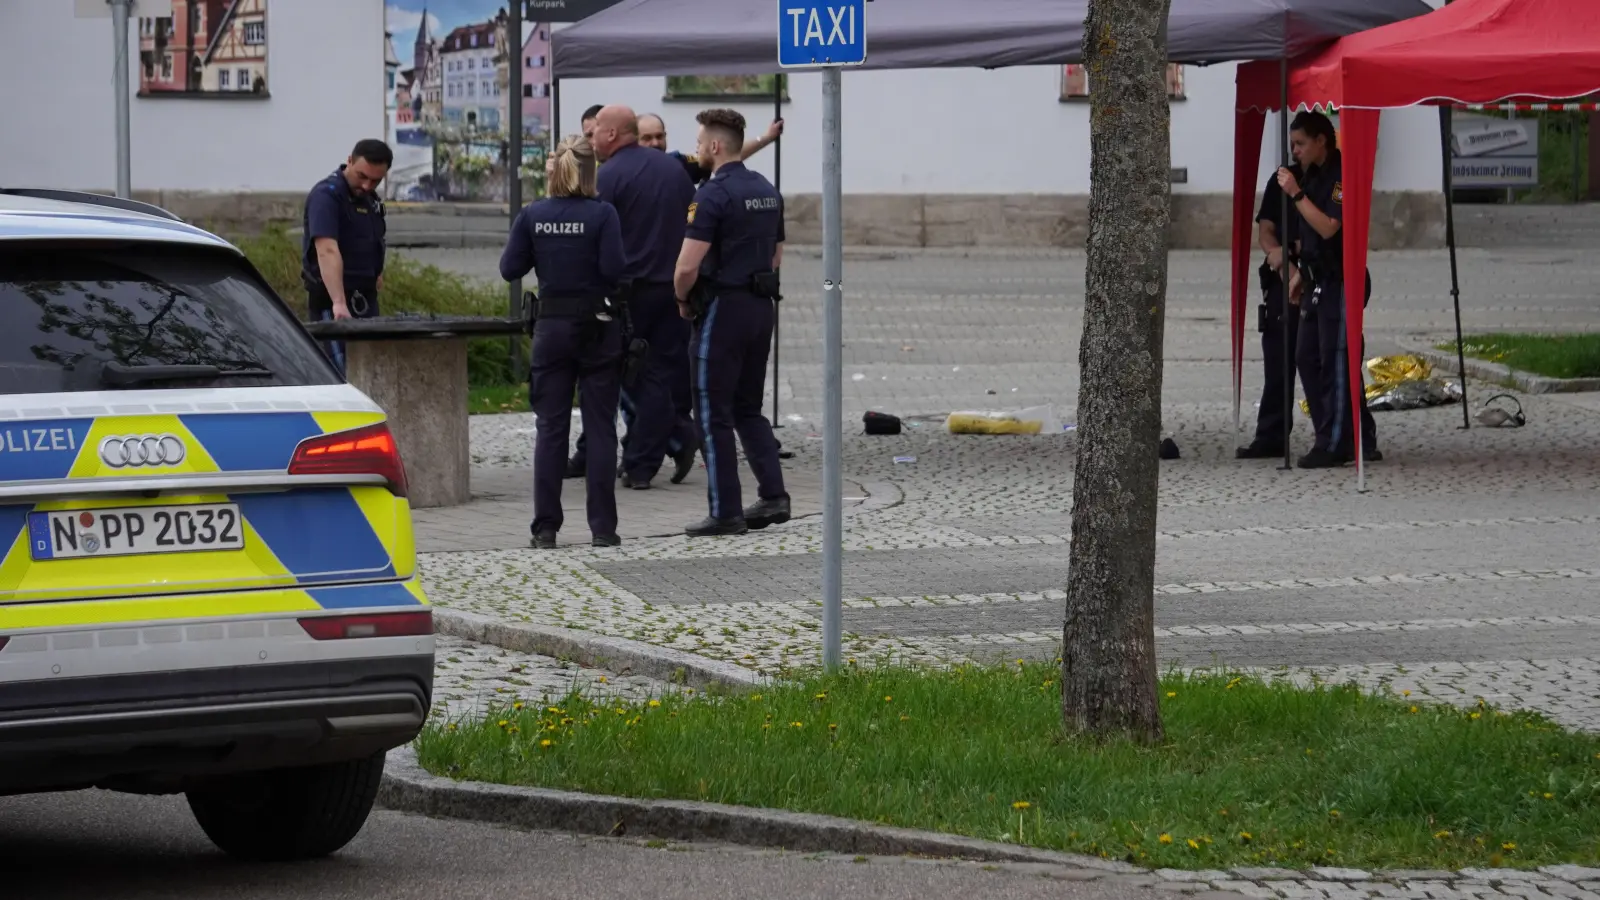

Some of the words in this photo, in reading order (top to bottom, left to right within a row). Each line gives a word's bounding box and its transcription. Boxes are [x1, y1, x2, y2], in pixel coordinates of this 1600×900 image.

[529, 0, 565, 10] Kurpark
[787, 5, 855, 47] TAXI
[1452, 165, 1499, 177] indsheimer
[1500, 164, 1532, 179] Zeitung
[744, 197, 777, 210] POLIZEI
[535, 222, 584, 234] POLIZEI
[37, 541, 46, 551] D
[53, 516, 78, 551] N
[100, 513, 145, 548] PP
[153, 508, 238, 546] 2032
